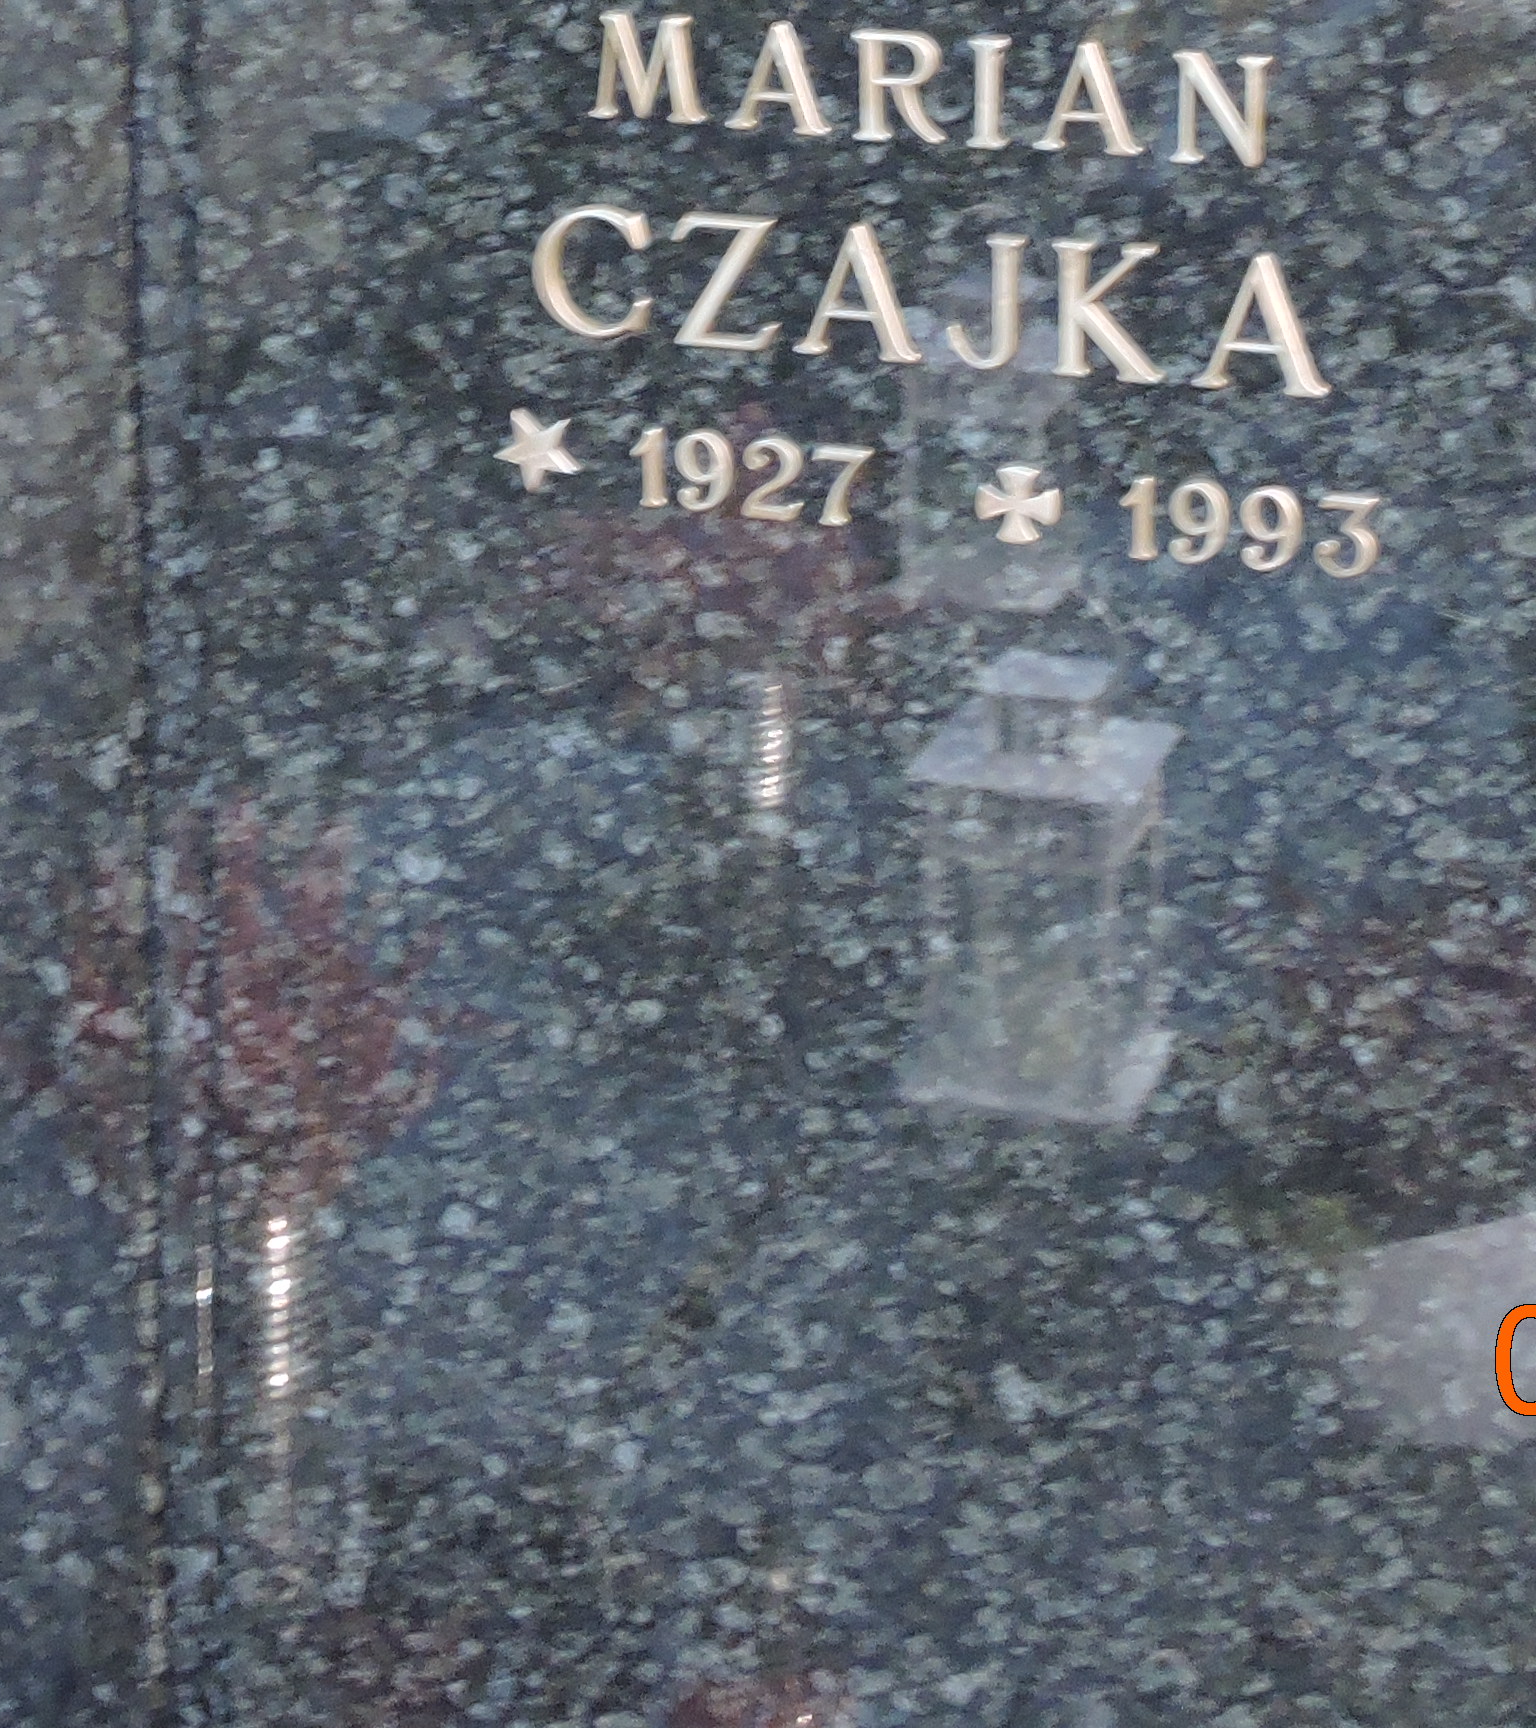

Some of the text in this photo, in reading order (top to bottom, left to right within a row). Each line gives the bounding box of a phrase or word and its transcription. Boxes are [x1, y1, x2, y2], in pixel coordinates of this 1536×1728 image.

[587, 9, 1274, 168] MARIAN
[530, 203, 1331, 399] CZAJKA
[629, 424, 1382, 579] 1927 1993
